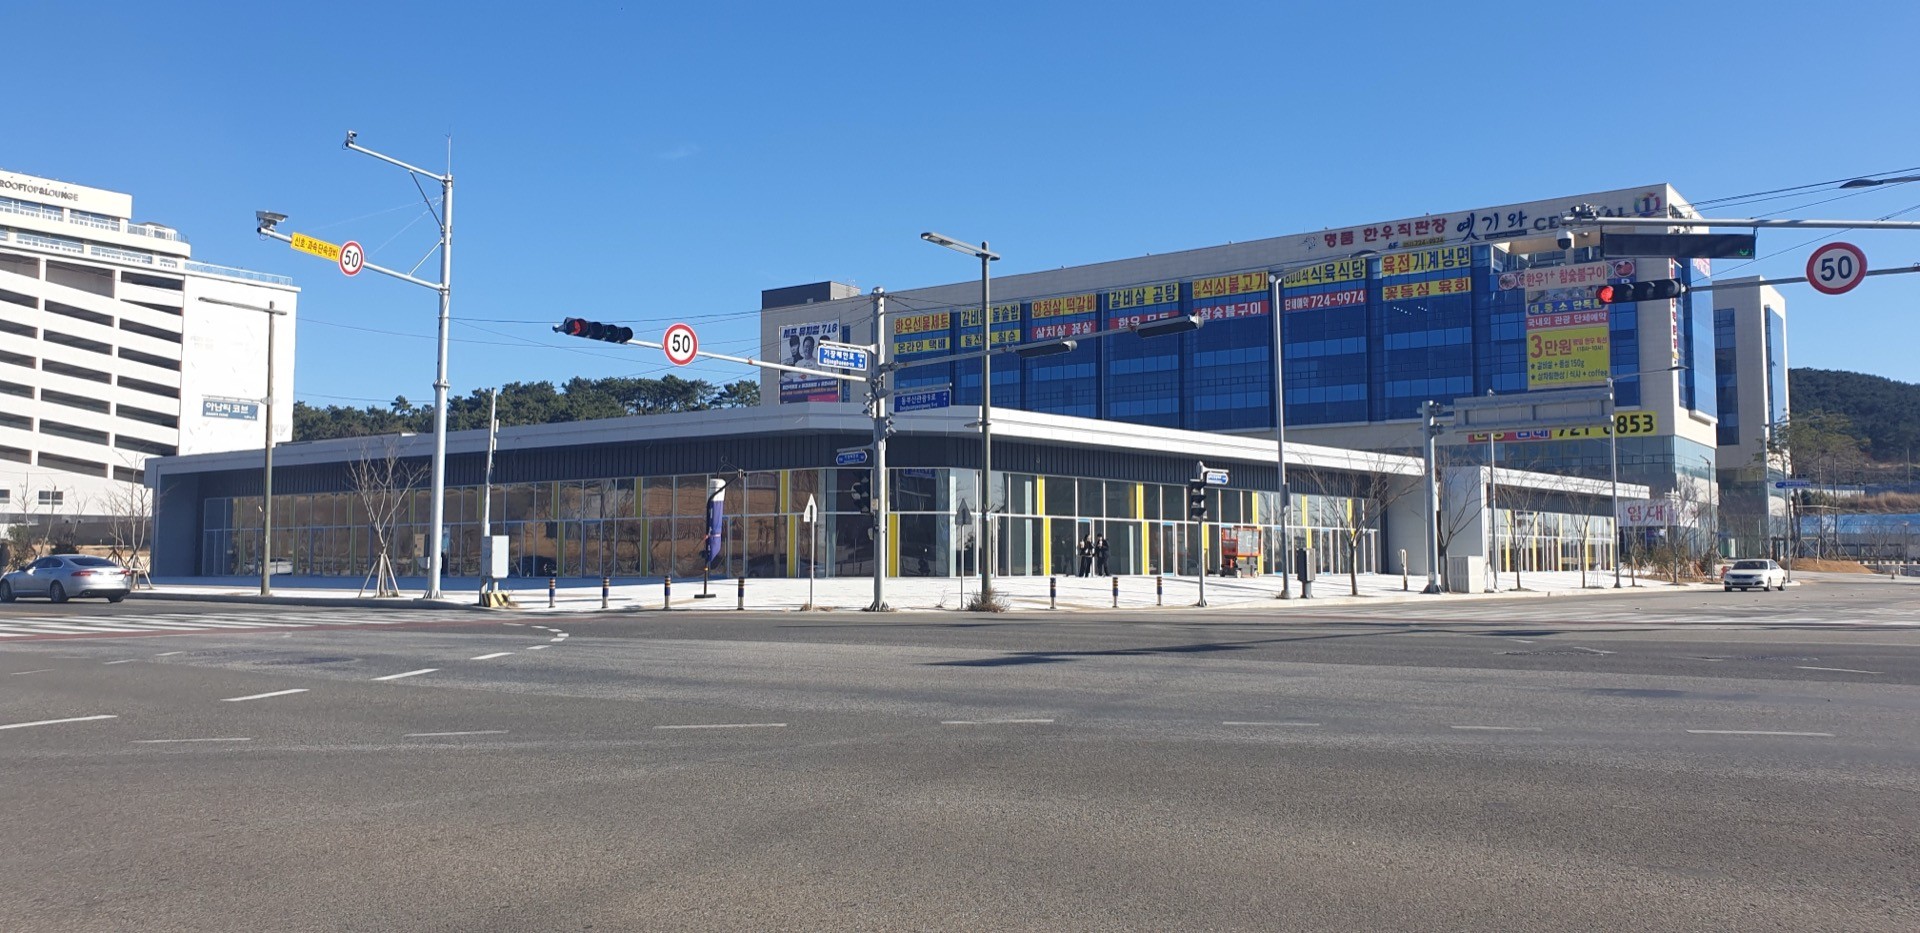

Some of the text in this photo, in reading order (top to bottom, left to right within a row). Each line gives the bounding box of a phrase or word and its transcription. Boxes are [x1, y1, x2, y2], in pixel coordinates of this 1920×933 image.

[1325, 218, 1447, 248] 명품 한우직판장
[344, 250, 359, 268] 50
[1821, 256, 1853, 281] 50
[1439, 278, 1469, 294] 육회
[1111, 283, 1176, 308] 갈비살 곰탕
[1310, 290, 1365, 308] 724-9974
[1201, 302, 1261, 320] 참숯불구이
[822, 323, 838, 334] 718
[1037, 324, 1067, 339] 살치살
[1528, 317, 1551, 328] 국내외
[672, 334, 691, 354] 50
[898, 341, 924, 354] 온라인
[1530, 334, 1572, 358] 3만원
